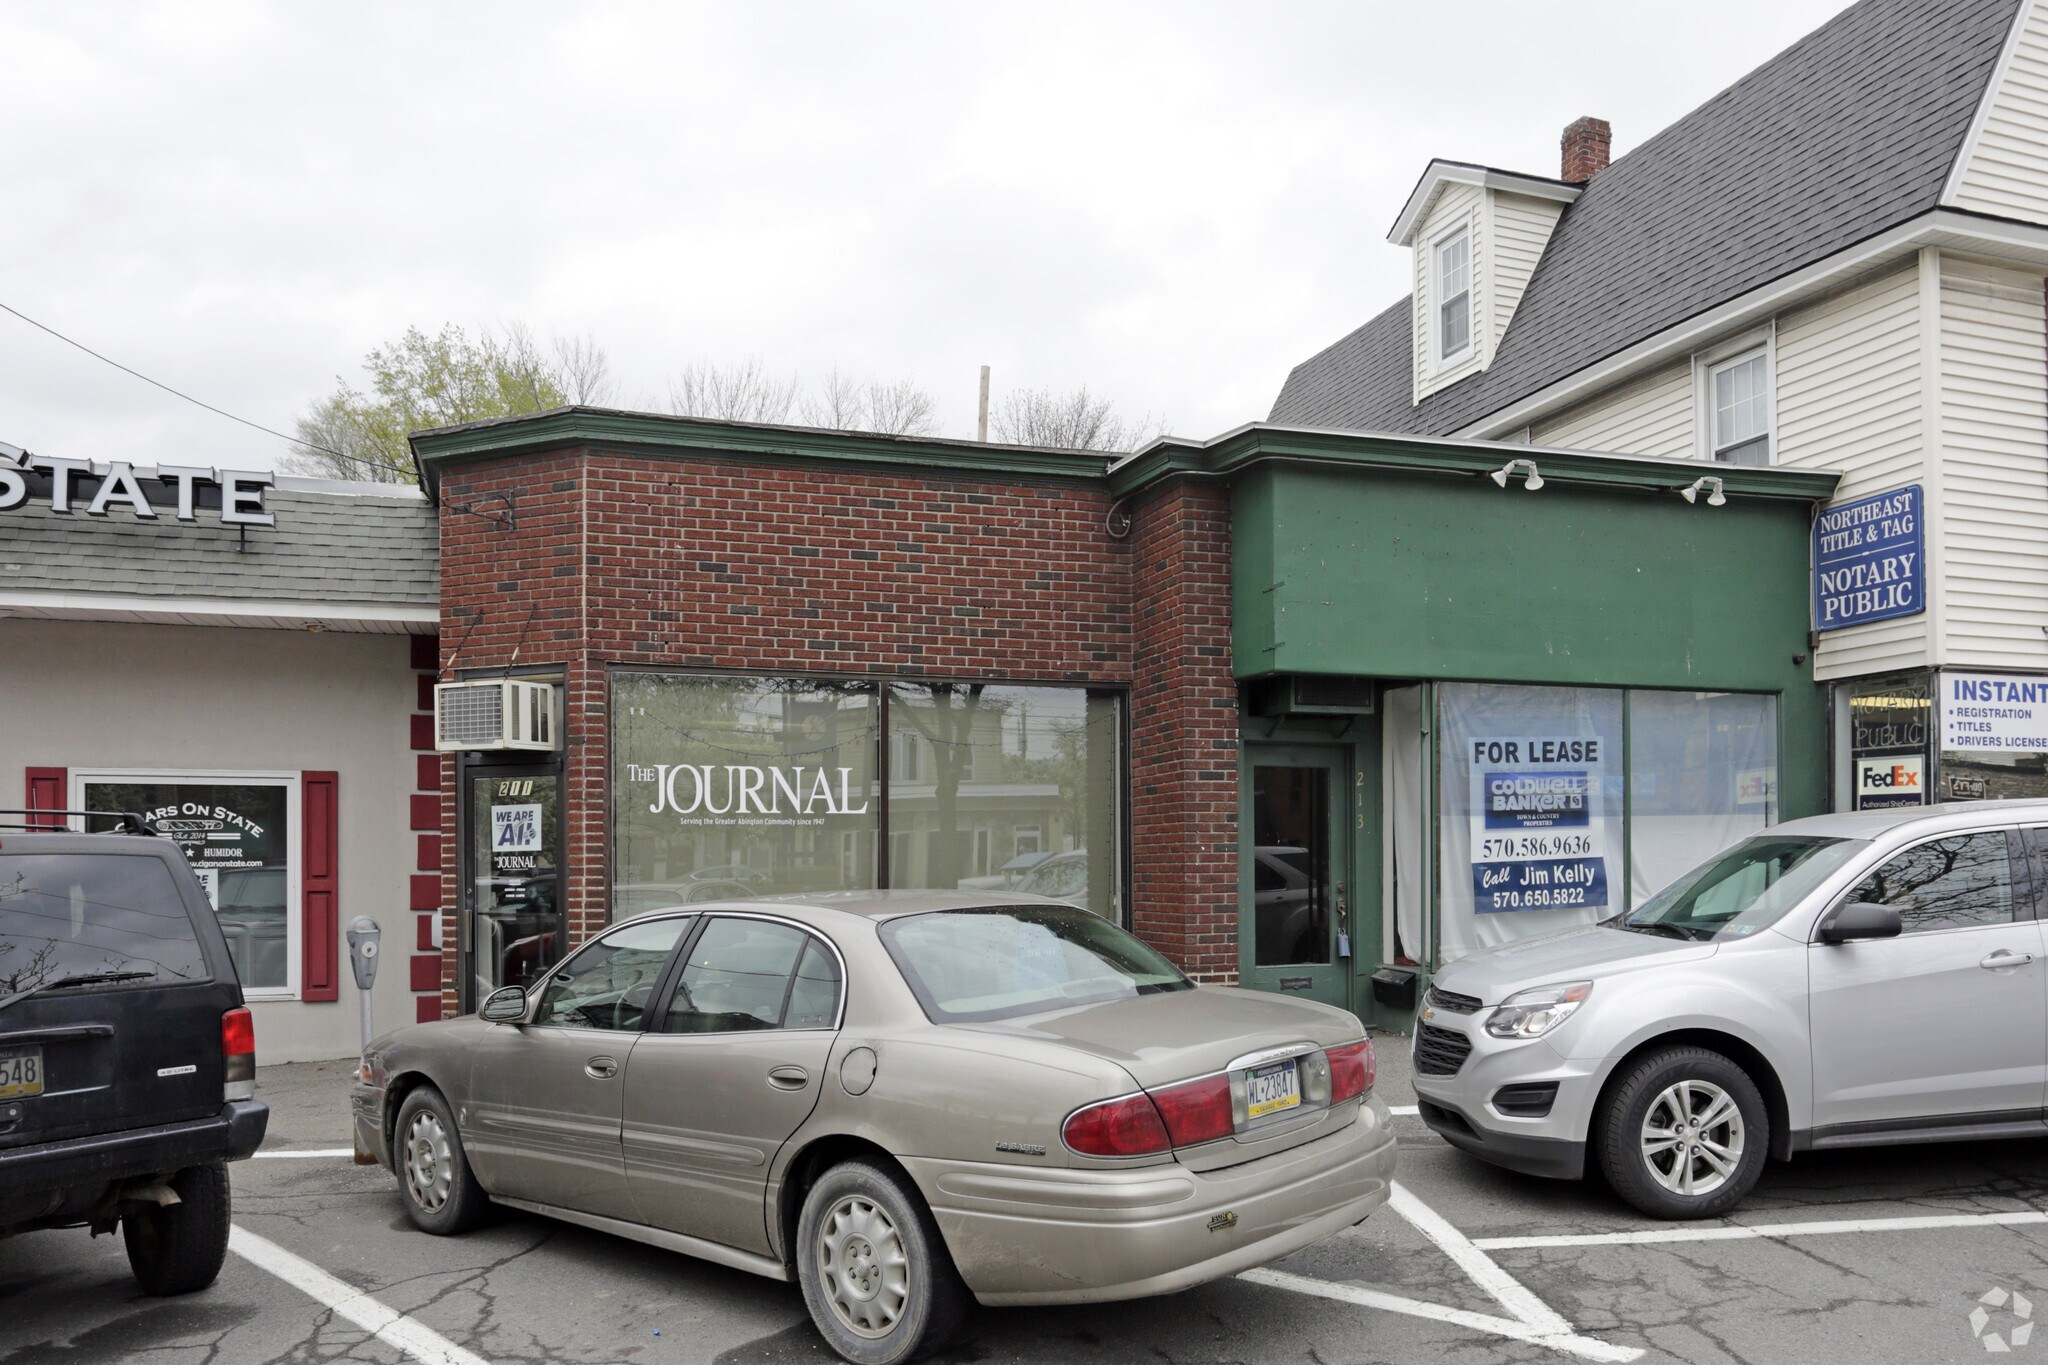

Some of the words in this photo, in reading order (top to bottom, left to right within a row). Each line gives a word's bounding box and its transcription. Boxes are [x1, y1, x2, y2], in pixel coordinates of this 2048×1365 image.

[1820, 493, 1912, 534] NORTHEAST
[1820, 528, 1862, 554] TITLE
[1866, 524, 1878, 543] &
[1881, 514, 1914, 539] TAG
[1820, 553, 1916, 596] NOTARY
[1824, 581, 1912, 621] PUBLIC
[1954, 679, 2048, 704] INSTANT
[1957, 707, 2032, 719] REGISTRATION
[1856, 722, 1922, 748] PUBLIC
[1957, 722, 1992, 732] TITLES
[1474, 742, 1520, 764] FOR
[1529, 741, 1598, 763] LEASE
[1957, 736, 2002, 747] DRIVERS
[2005, 737, 2048, 748] LICENSE
[1491, 777, 1582, 795] COLDWELL
[1863, 765, 1918, 788] FedEx
[499, 781, 533, 796] 211
[627, 764, 655, 782] THE
[649, 764, 868, 814] JOURNAL
[1493, 794, 1566, 812] BANKER
[1862, 800, 1890, 808] Authorized
[182, 802, 209, 816] ON
[213, 807, 264, 838] STATE
[496, 812, 512, 822] WE
[513, 811, 533, 821] ARE
[680, 818, 702, 826] Serving
[738, 818, 763, 826] Abington
[764, 818, 796, 826] Community
[204, 848, 243, 857] HUMIDOR
[1483, 835, 1592, 859] 570.586.9636
[498, 856, 536, 868] JOURNAL
[1482, 866, 1511, 888] Call
[1520, 865, 1549, 886] Jim
[1553, 863, 1595, 887] Kelly
[1493, 887, 1585, 908] 570.650.5822
